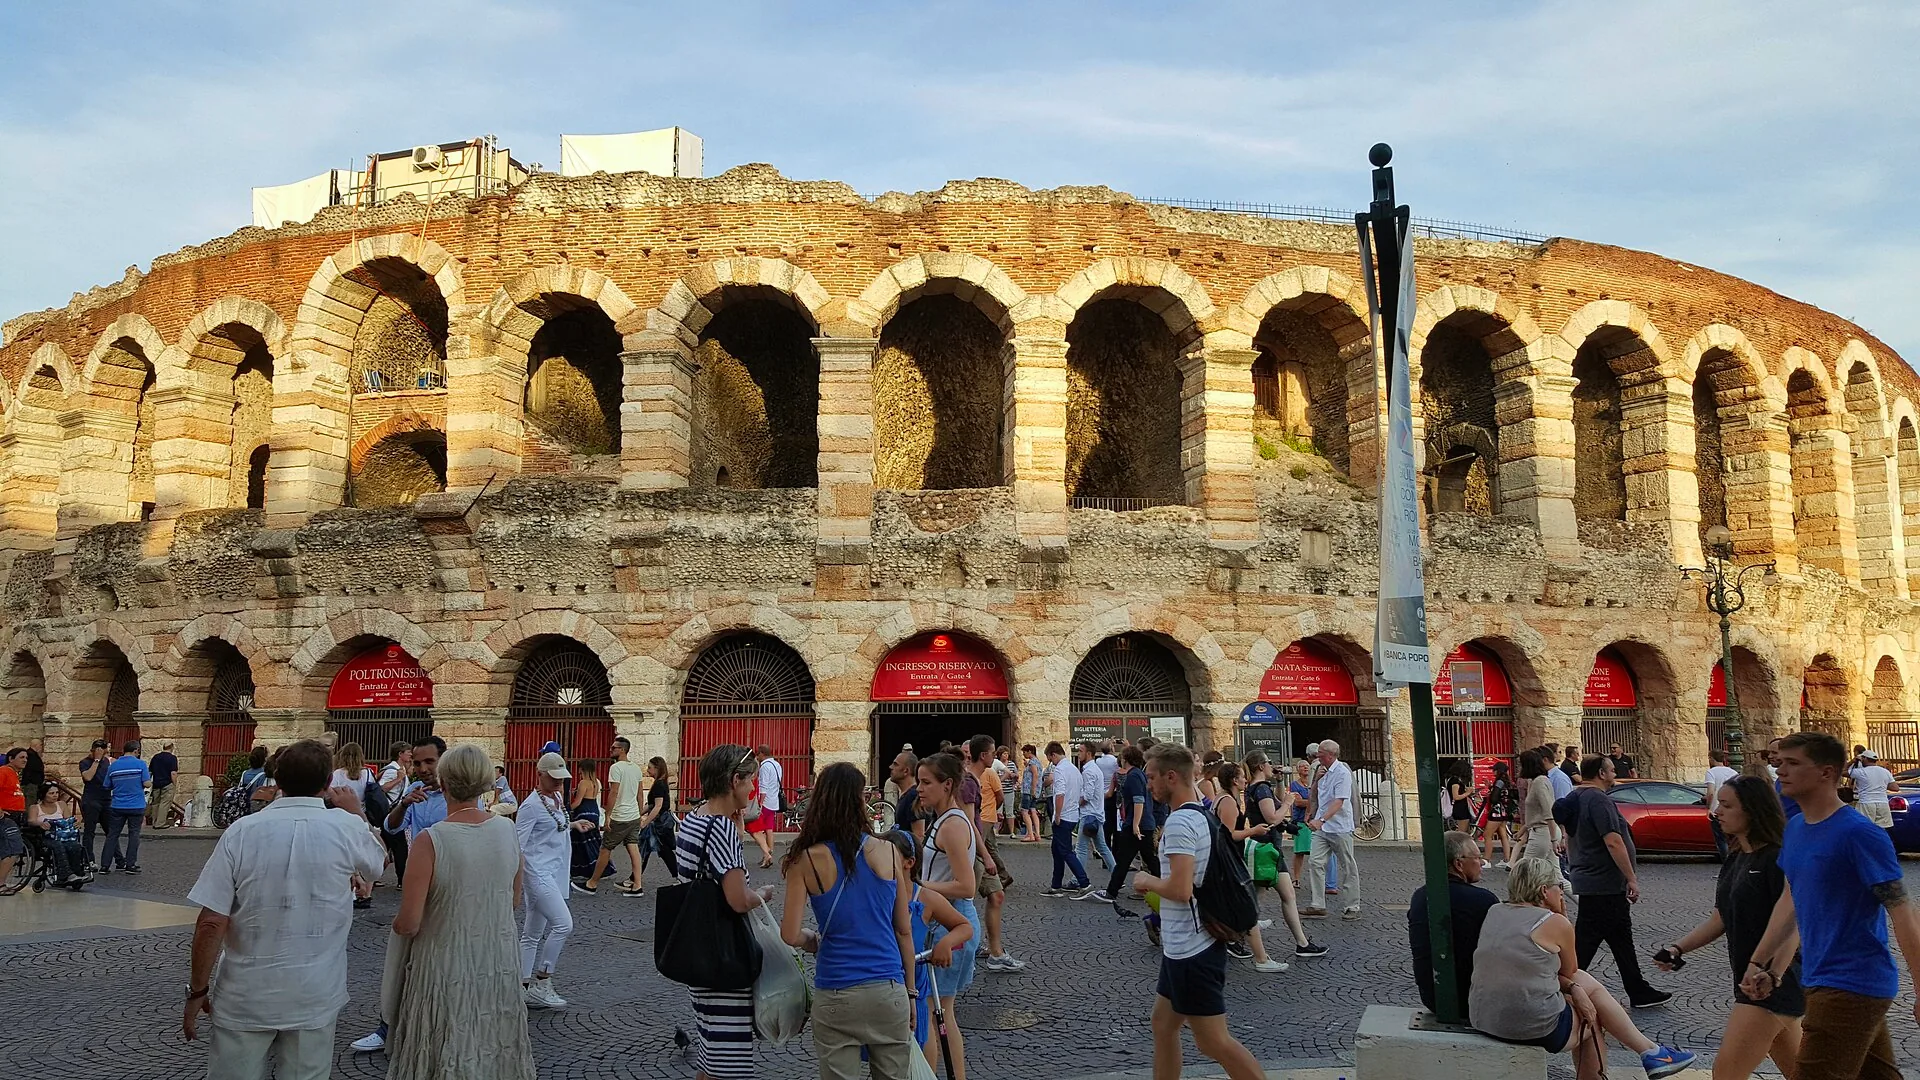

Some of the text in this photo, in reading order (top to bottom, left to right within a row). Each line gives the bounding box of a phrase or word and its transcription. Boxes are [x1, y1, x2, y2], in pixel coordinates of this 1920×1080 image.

[1386, 649, 1429, 663] BANCA POPO
[885, 662, 996, 671] INGRESSO RISERVATO
